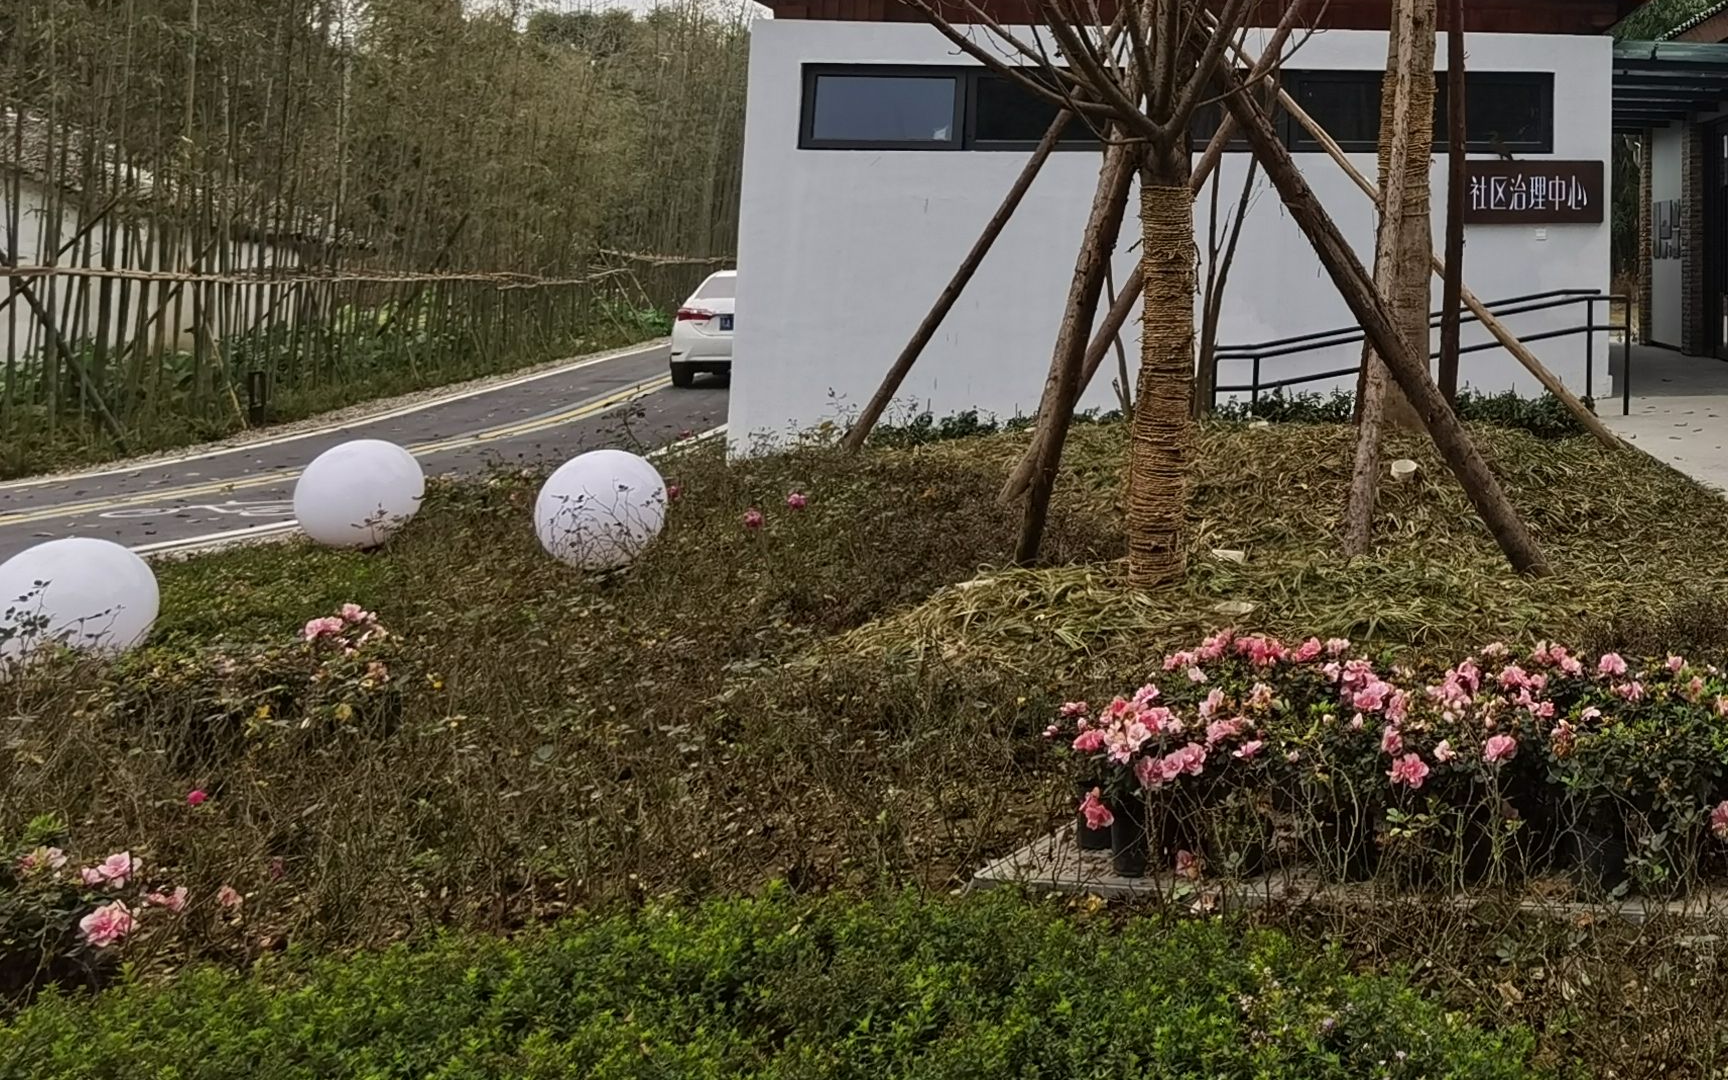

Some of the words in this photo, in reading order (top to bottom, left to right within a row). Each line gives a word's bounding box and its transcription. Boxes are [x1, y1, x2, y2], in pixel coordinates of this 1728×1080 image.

[1470, 173, 1588, 211] 社区治理中心
